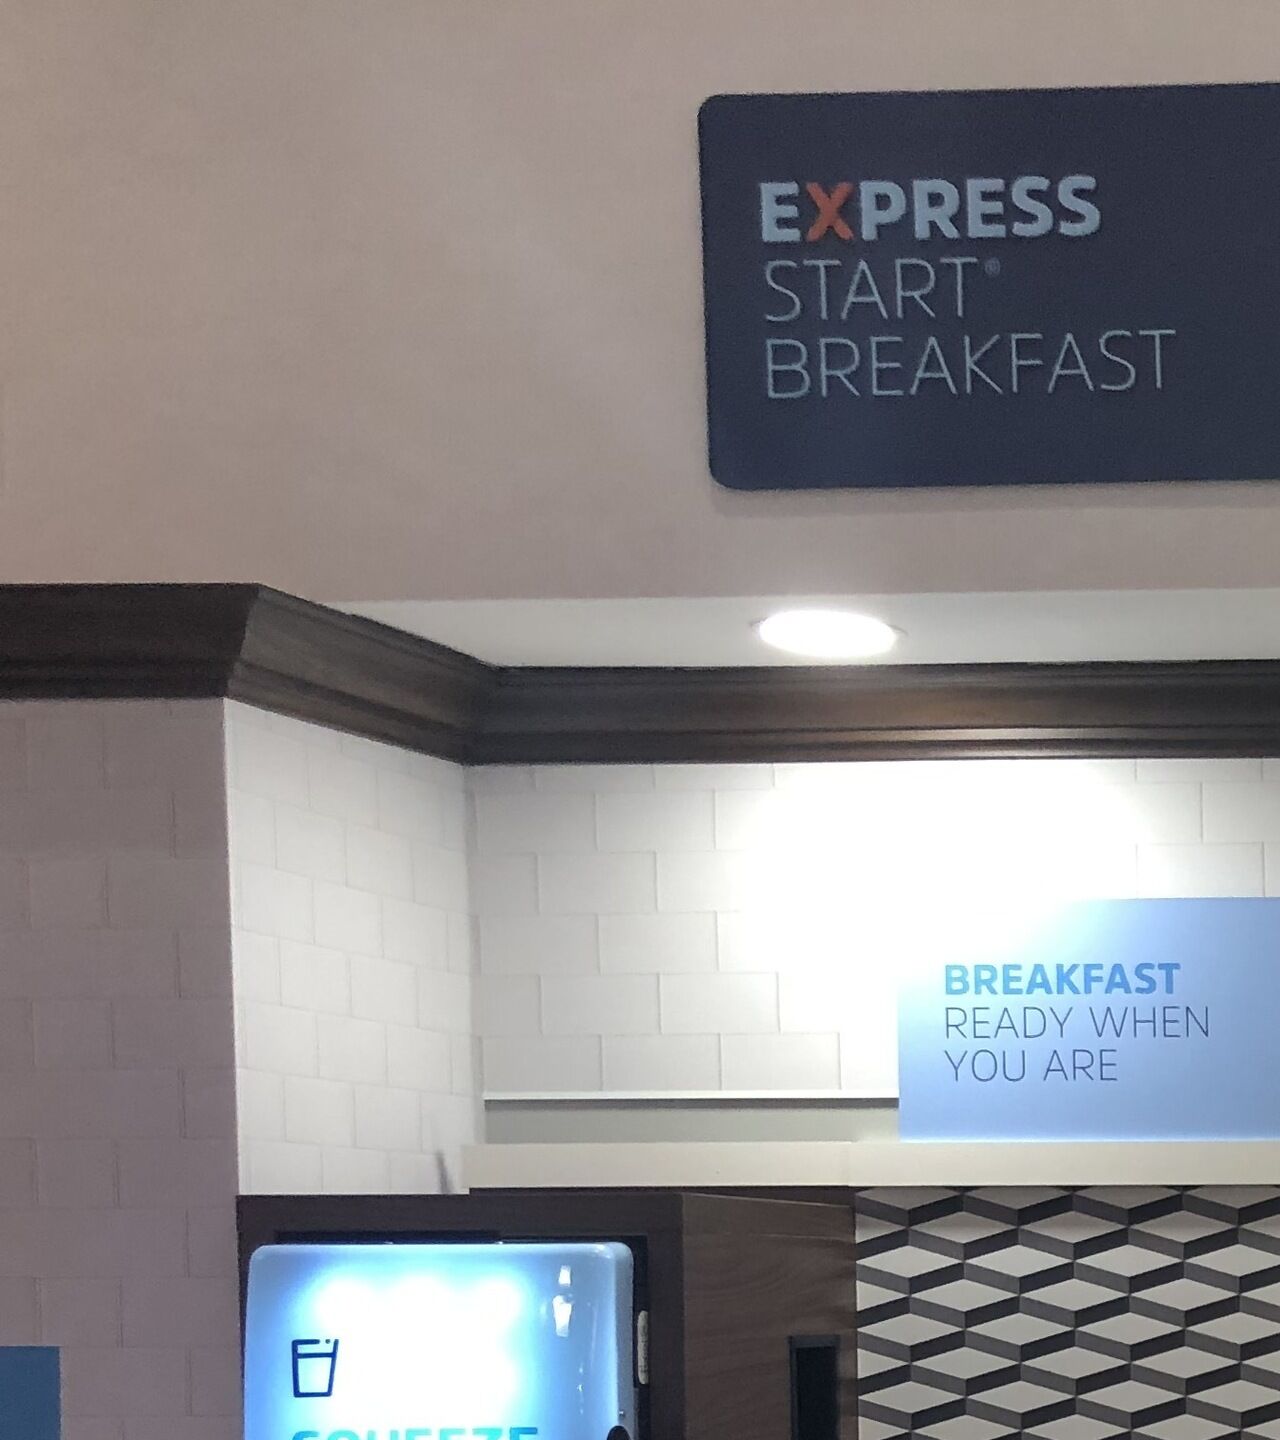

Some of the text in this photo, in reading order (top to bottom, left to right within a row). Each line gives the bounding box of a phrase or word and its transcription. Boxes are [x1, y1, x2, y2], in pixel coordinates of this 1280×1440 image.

[759, 173, 1101, 243] EXPRESS
[765, 328, 1177, 399] BREAKFAST
[944, 962, 1181, 996] BREAKFAST
[944, 1005, 1210, 1039] READY WHEN
[944, 1048, 1118, 1082] YOU ARE
